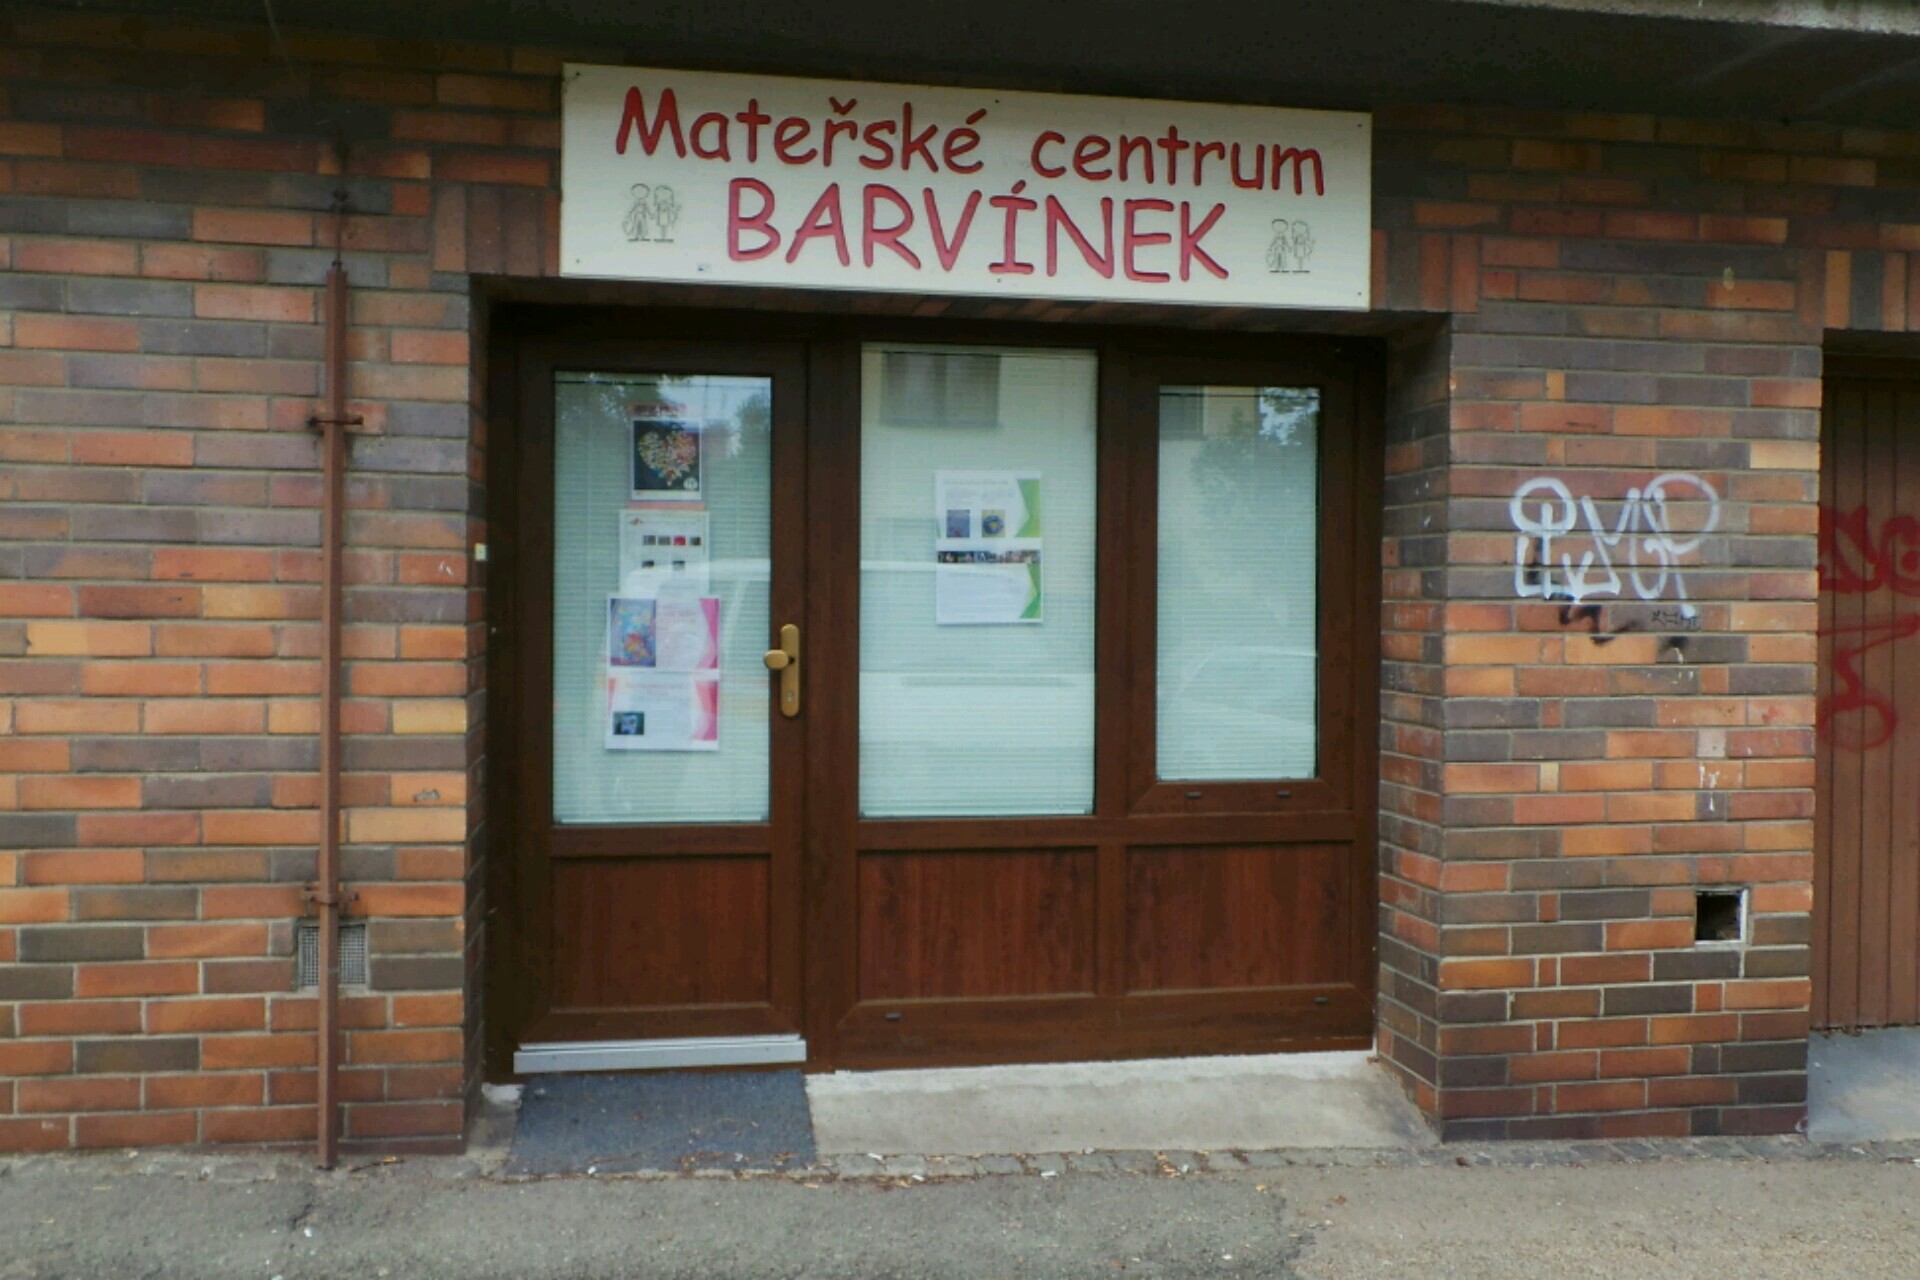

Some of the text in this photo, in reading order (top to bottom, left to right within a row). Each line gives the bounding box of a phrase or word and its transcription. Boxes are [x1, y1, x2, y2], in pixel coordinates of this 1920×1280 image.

[615, 86, 1325, 196] Mateřské centrum
[727, 178, 1229, 283] BARVÍNEK
